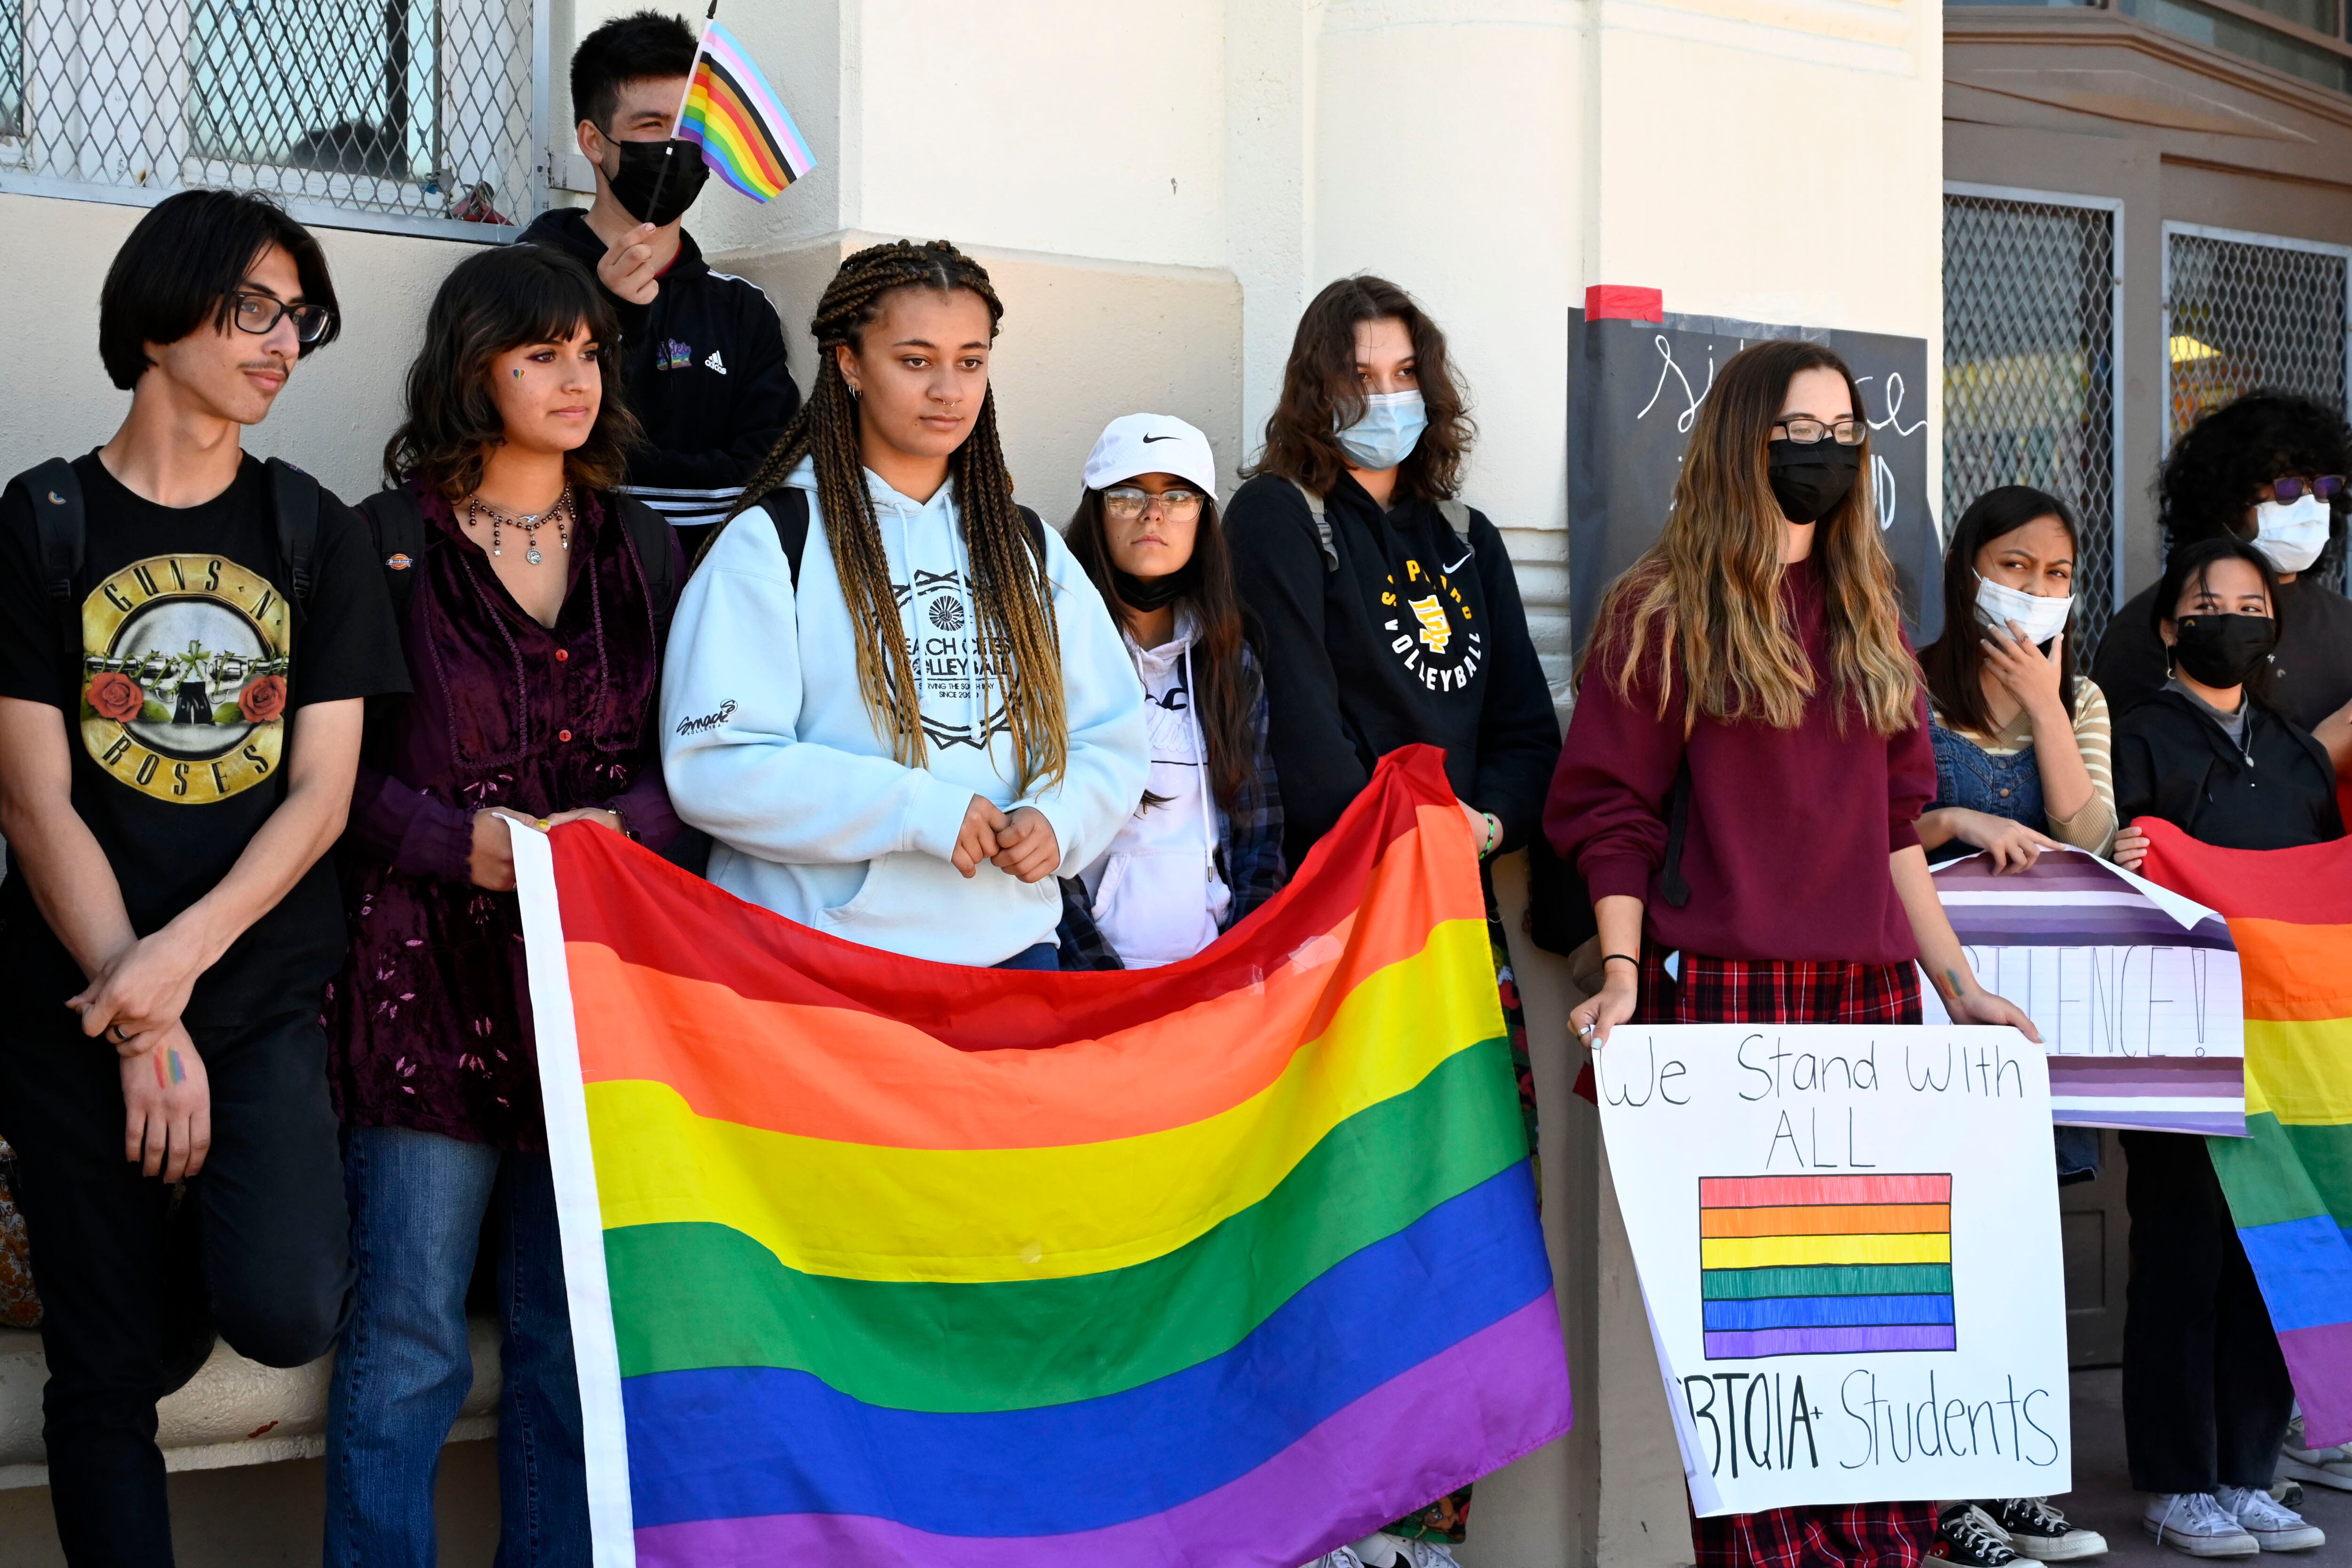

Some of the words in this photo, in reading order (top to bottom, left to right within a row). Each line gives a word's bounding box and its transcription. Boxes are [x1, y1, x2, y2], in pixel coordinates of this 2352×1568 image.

[705, 359, 727, 375] adidas
[103, 559, 222, 612] GUNS
[905, 637, 957, 655] EACH
[102, 735, 269, 796] ROSES
[1600, 1036, 1692, 1107] We
[1737, 1034, 1879, 1101] Stand
[1766, 1107, 1876, 1170] ALL
[1676, 1373, 1823, 1479] BTQIA+
[1839, 1369, 2058, 1469] Students
